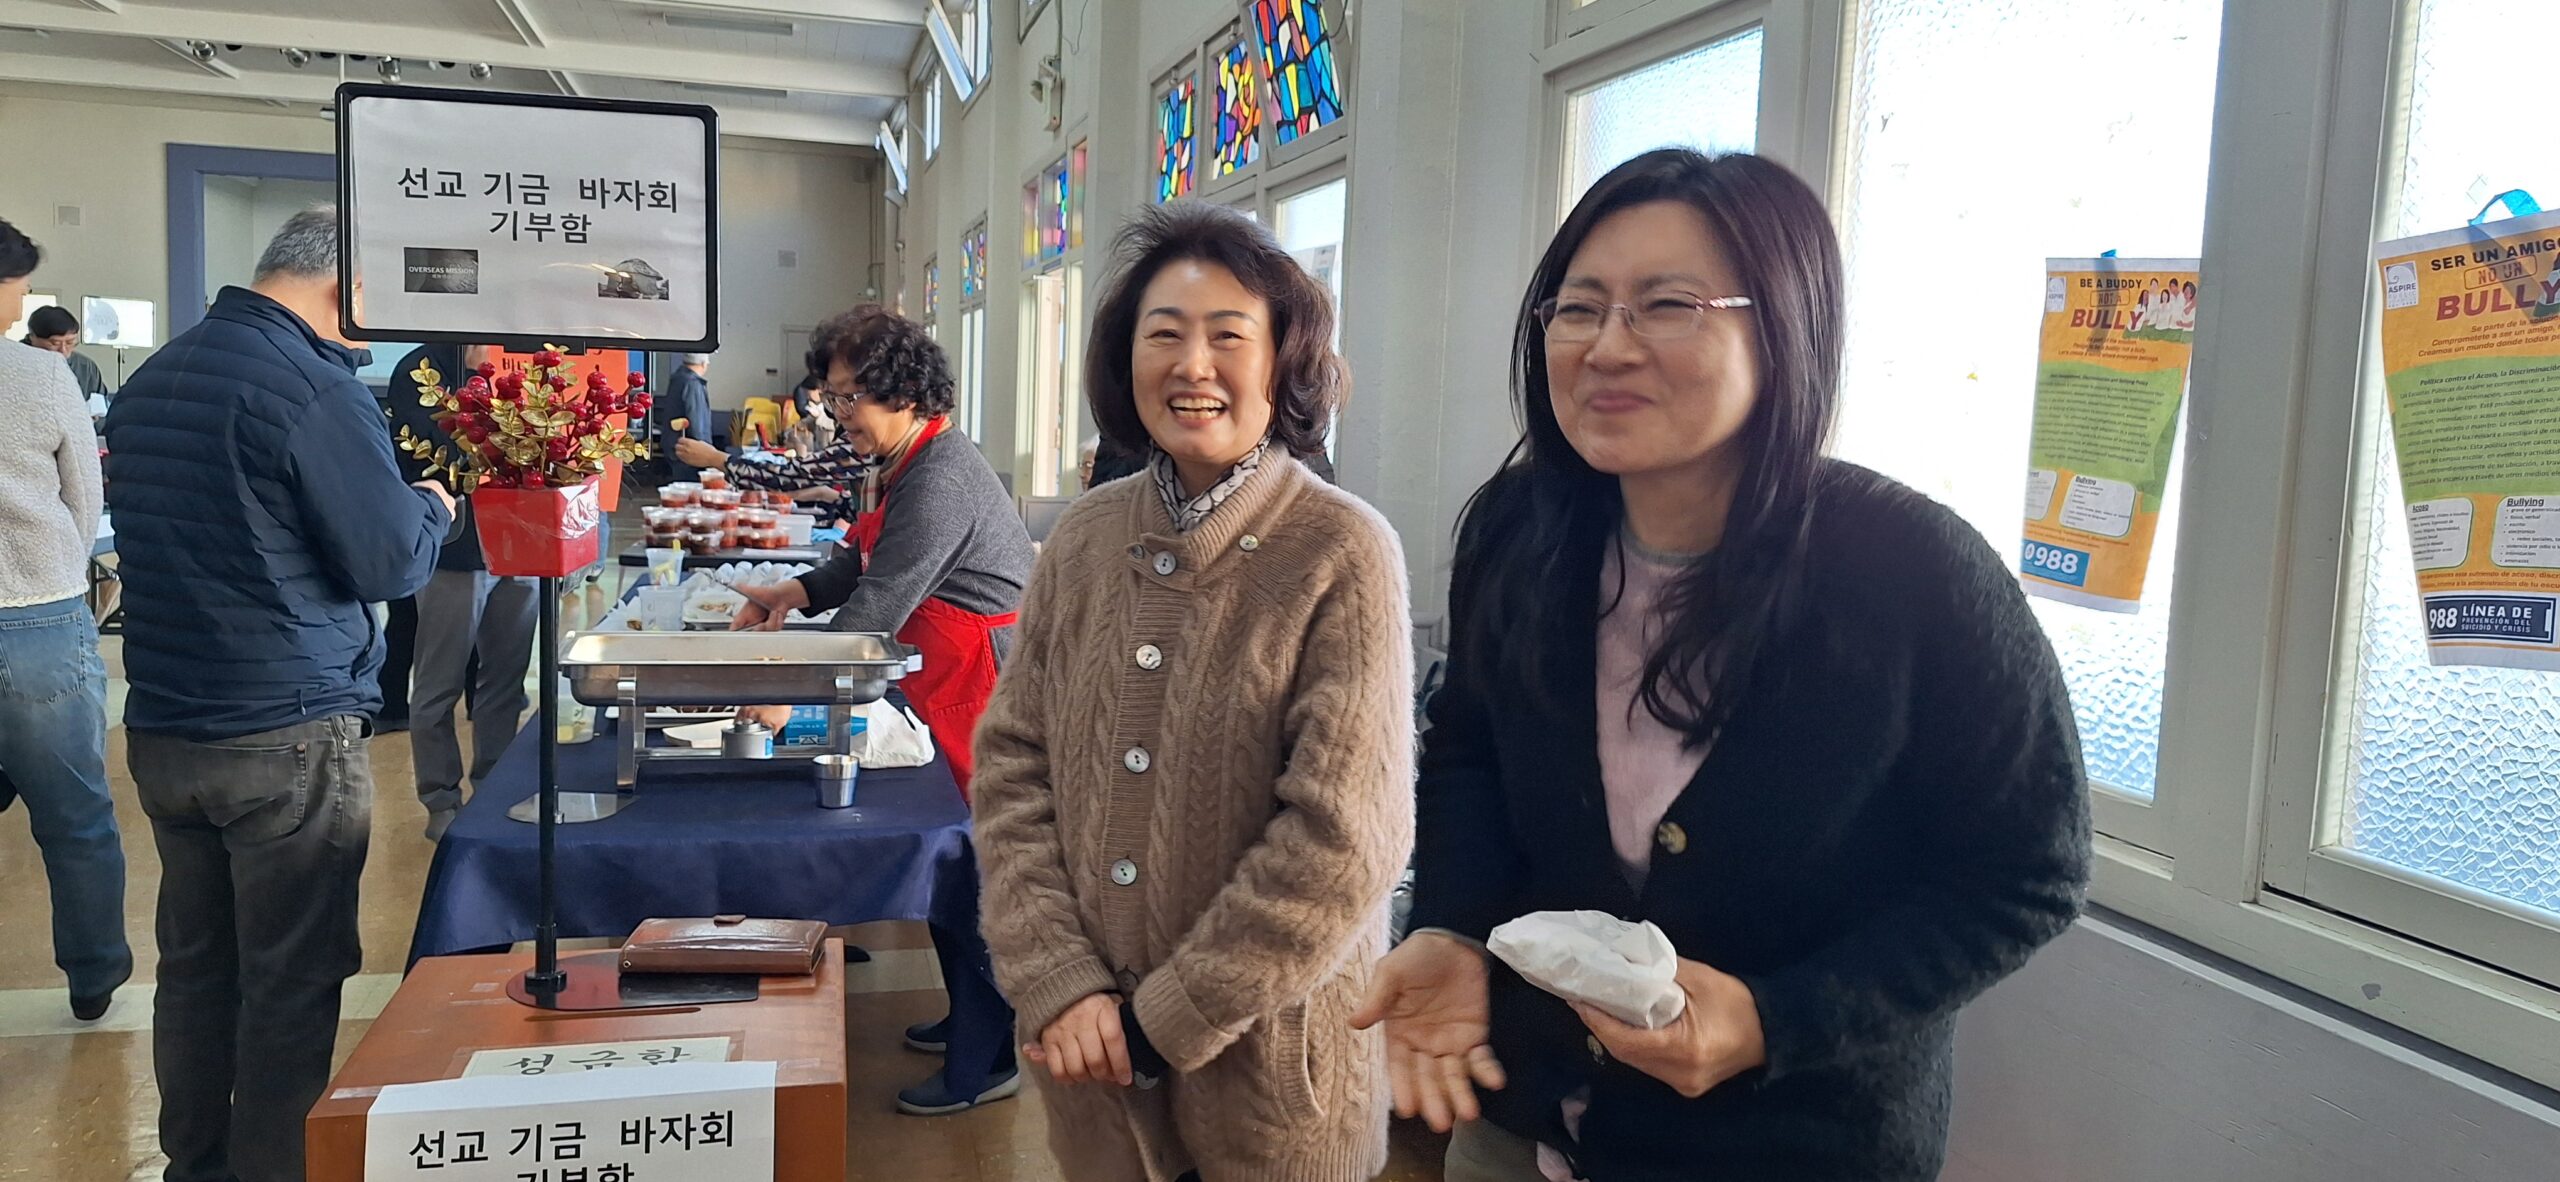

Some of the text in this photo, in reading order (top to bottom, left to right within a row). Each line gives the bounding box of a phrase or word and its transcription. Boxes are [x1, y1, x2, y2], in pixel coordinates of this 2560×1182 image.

[398, 168, 678, 213] 선교 기금 바자회
[489, 210, 592, 243] 기부함
[2431, 239, 2560, 271] SER UN AMIG
[2080, 278, 2143, 289] BE A BUDDY
[2477, 262, 2522, 285] NO UN
[2388, 283, 2417, 293] ASPIRE
[2098, 293, 2113, 305] NOT
[2436, 279, 2560, 321] BULLY
[2071, 309, 2144, 330] BULLY
[2471, 325, 2482, 333] Se
[2483, 323, 2504, 332] parte
[2527, 325, 2555, 335] amigo,
[2418, 347, 2452, 357] Creamos
[2466, 343, 2494, 351] mundo
[2496, 339, 2523, 348] donde
[2525, 335, 2549, 344] todos
[2419, 378, 2443, 386] Política
[2445, 375, 2467, 383] contra
[2506, 497, 2545, 507] Bullying
[2429, 603, 2532, 630] 988 LÍNEA DE
[2462, 617, 2510, 625] PREVENCIÓN
[408, 1109, 735, 1170] 선교 기금 바자회
